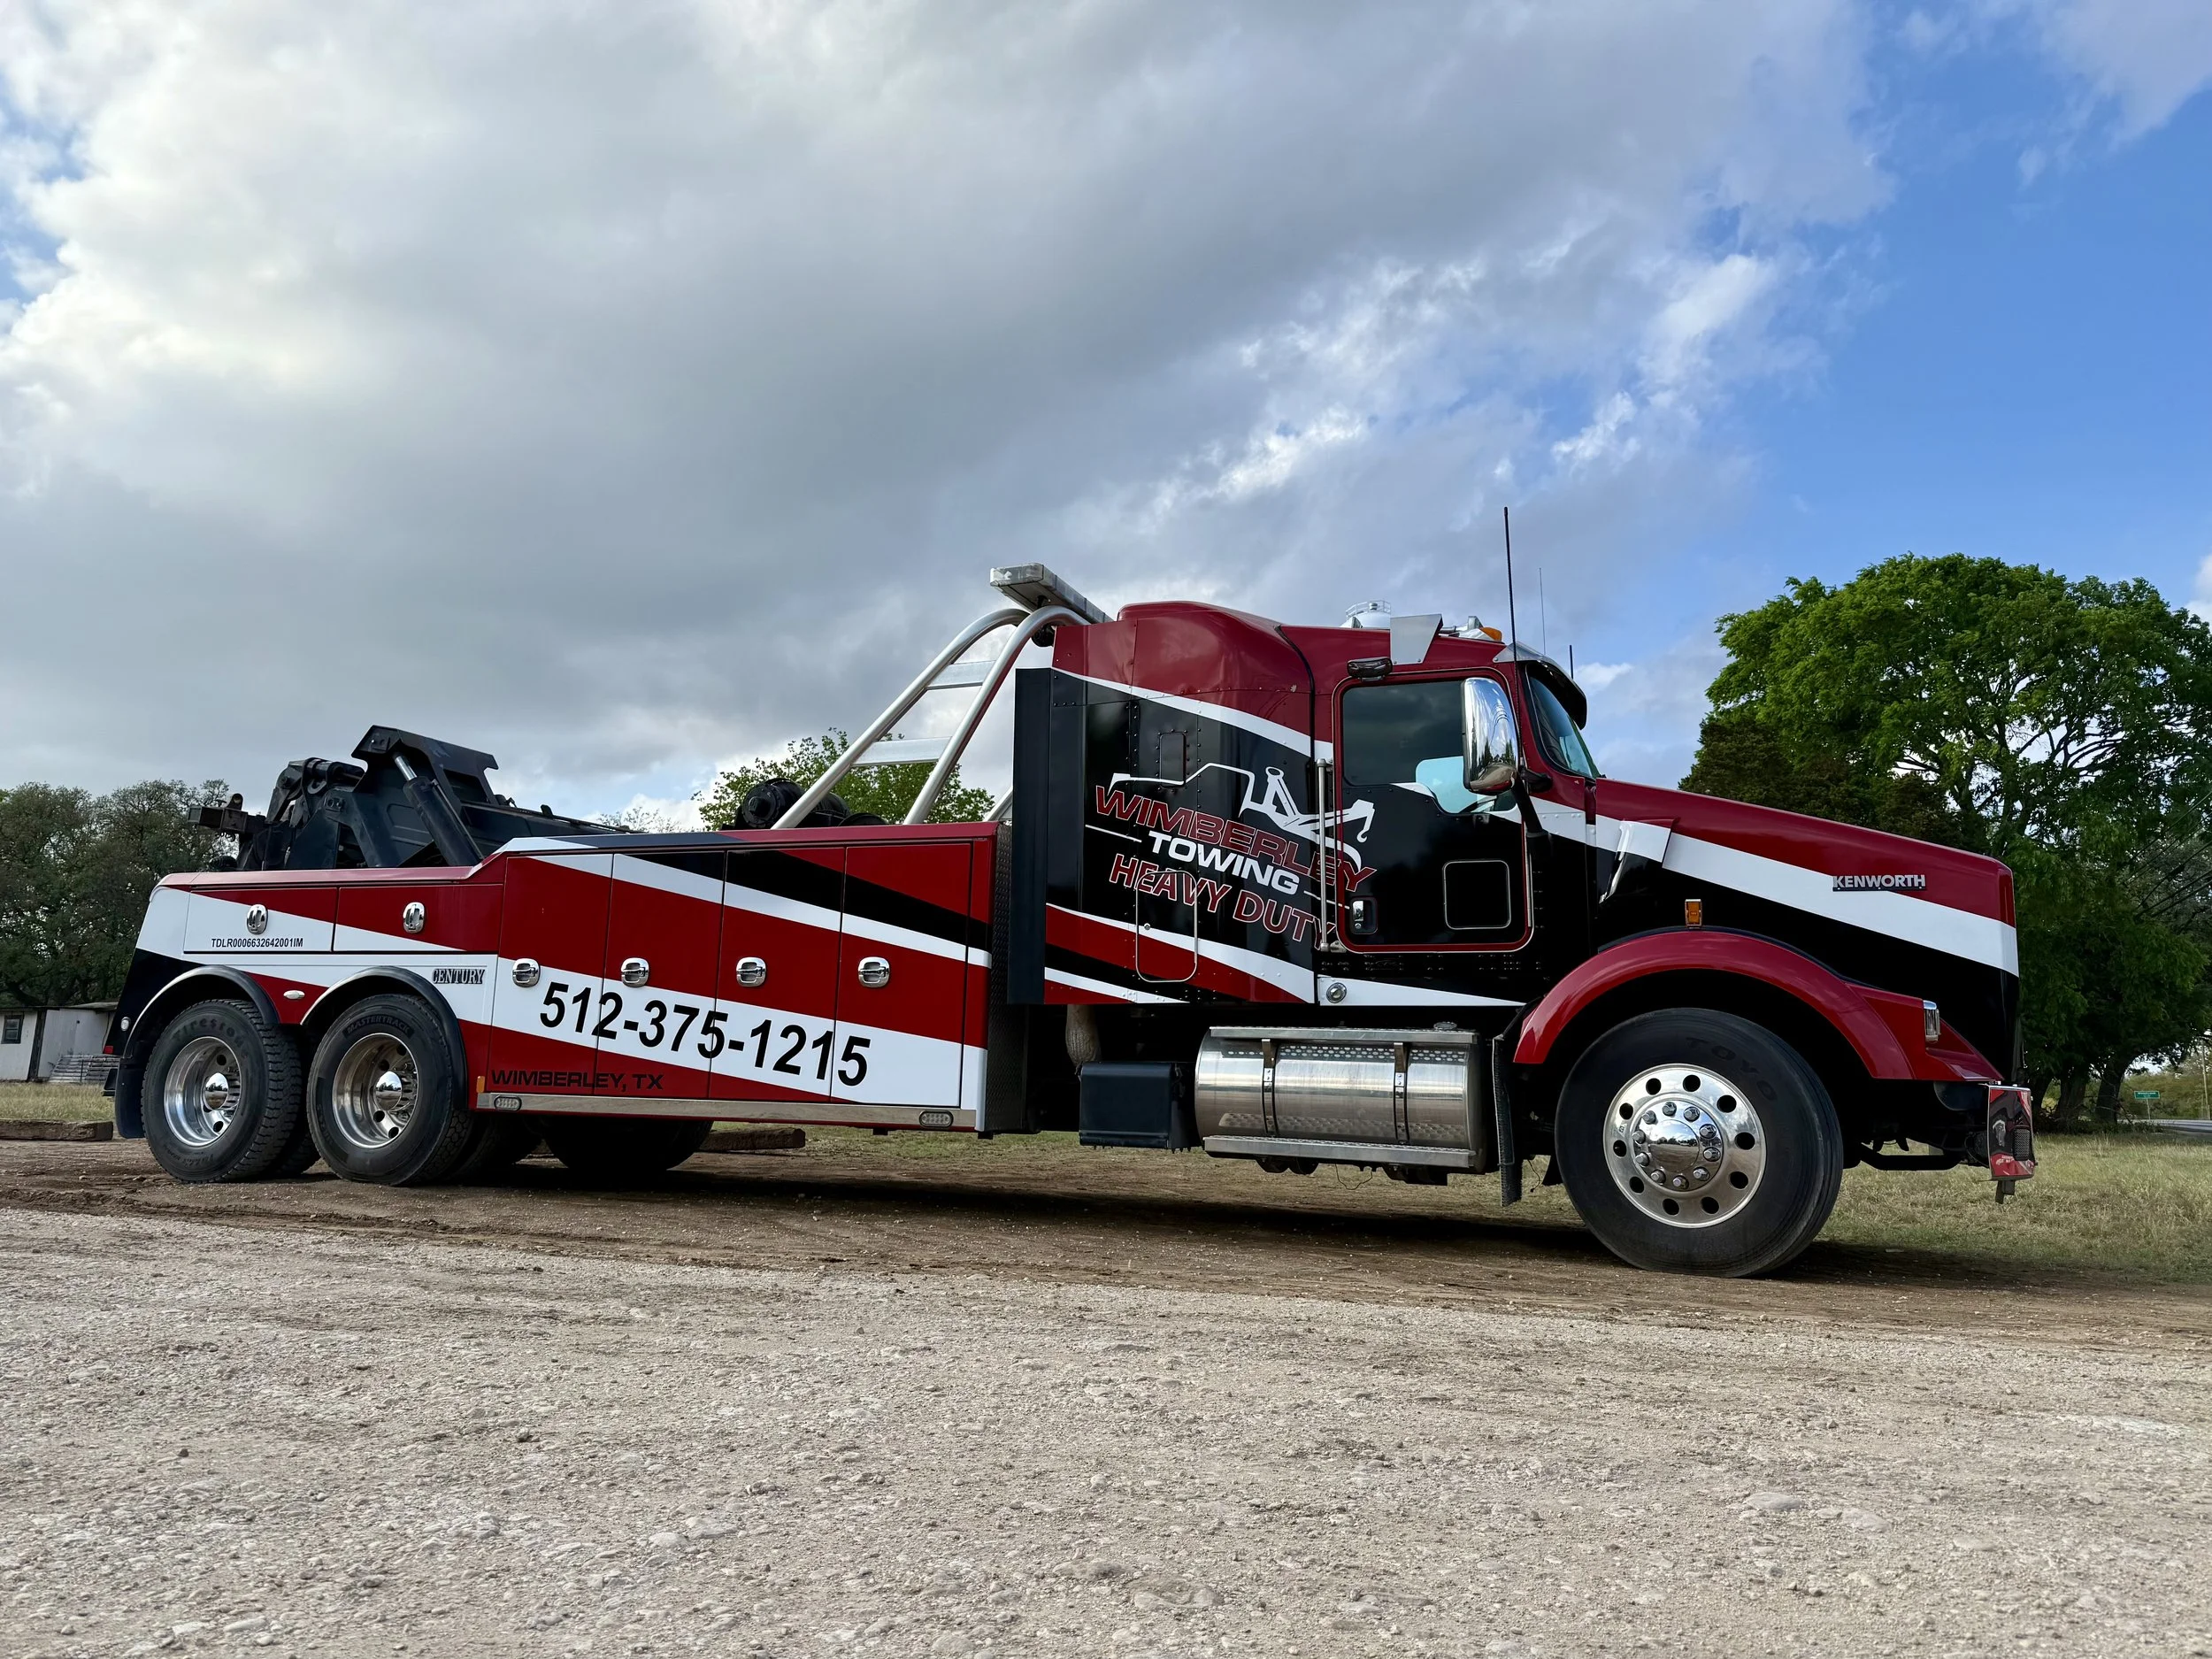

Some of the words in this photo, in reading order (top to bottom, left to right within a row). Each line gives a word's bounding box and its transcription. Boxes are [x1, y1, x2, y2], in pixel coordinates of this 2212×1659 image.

[1095, 785, 1377, 892] WIMBERLEY
[1148, 831, 1300, 895] TOWING
[1109, 853, 1232, 912] HEAVY
[1233, 889, 1336, 951] DUTY
[1832, 874, 1926, 888] KENWORTH
[432, 968, 485, 984] CENTURY
[346, 1014, 411, 1034] MASTERTRACK
[540, 981, 871, 1087] 512-375-1215
[492, 1070, 626, 1092] WIMBERLEY,
[632, 1074, 664, 1089] TX
[1685, 1036, 1778, 1102] TOYO
